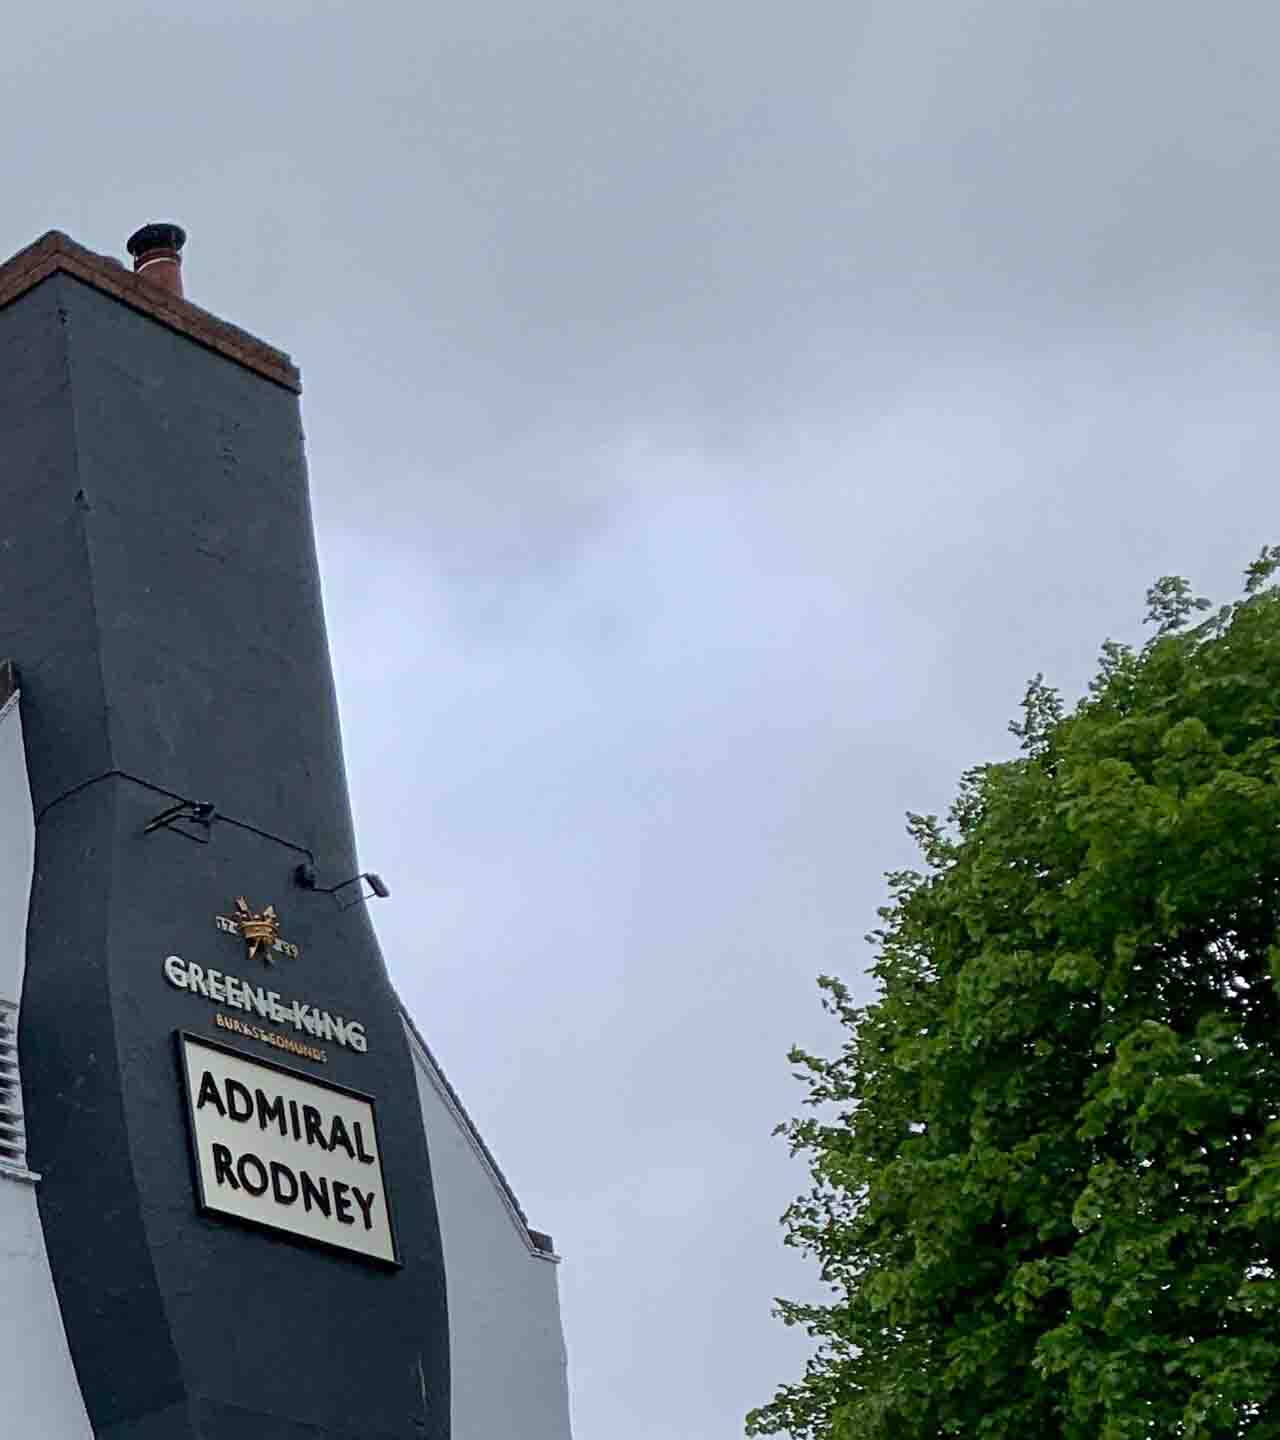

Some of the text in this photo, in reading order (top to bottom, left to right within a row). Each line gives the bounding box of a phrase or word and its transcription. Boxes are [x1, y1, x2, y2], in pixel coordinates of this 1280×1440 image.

[164, 955, 368, 1053] GREENE KING
[216, 1013, 249, 1034] BURY
[271, 1033, 328, 1063] EDMUNDS
[197, 1070, 376, 1165] ADMIRAL
[212, 1142, 376, 1231] RODNEY
